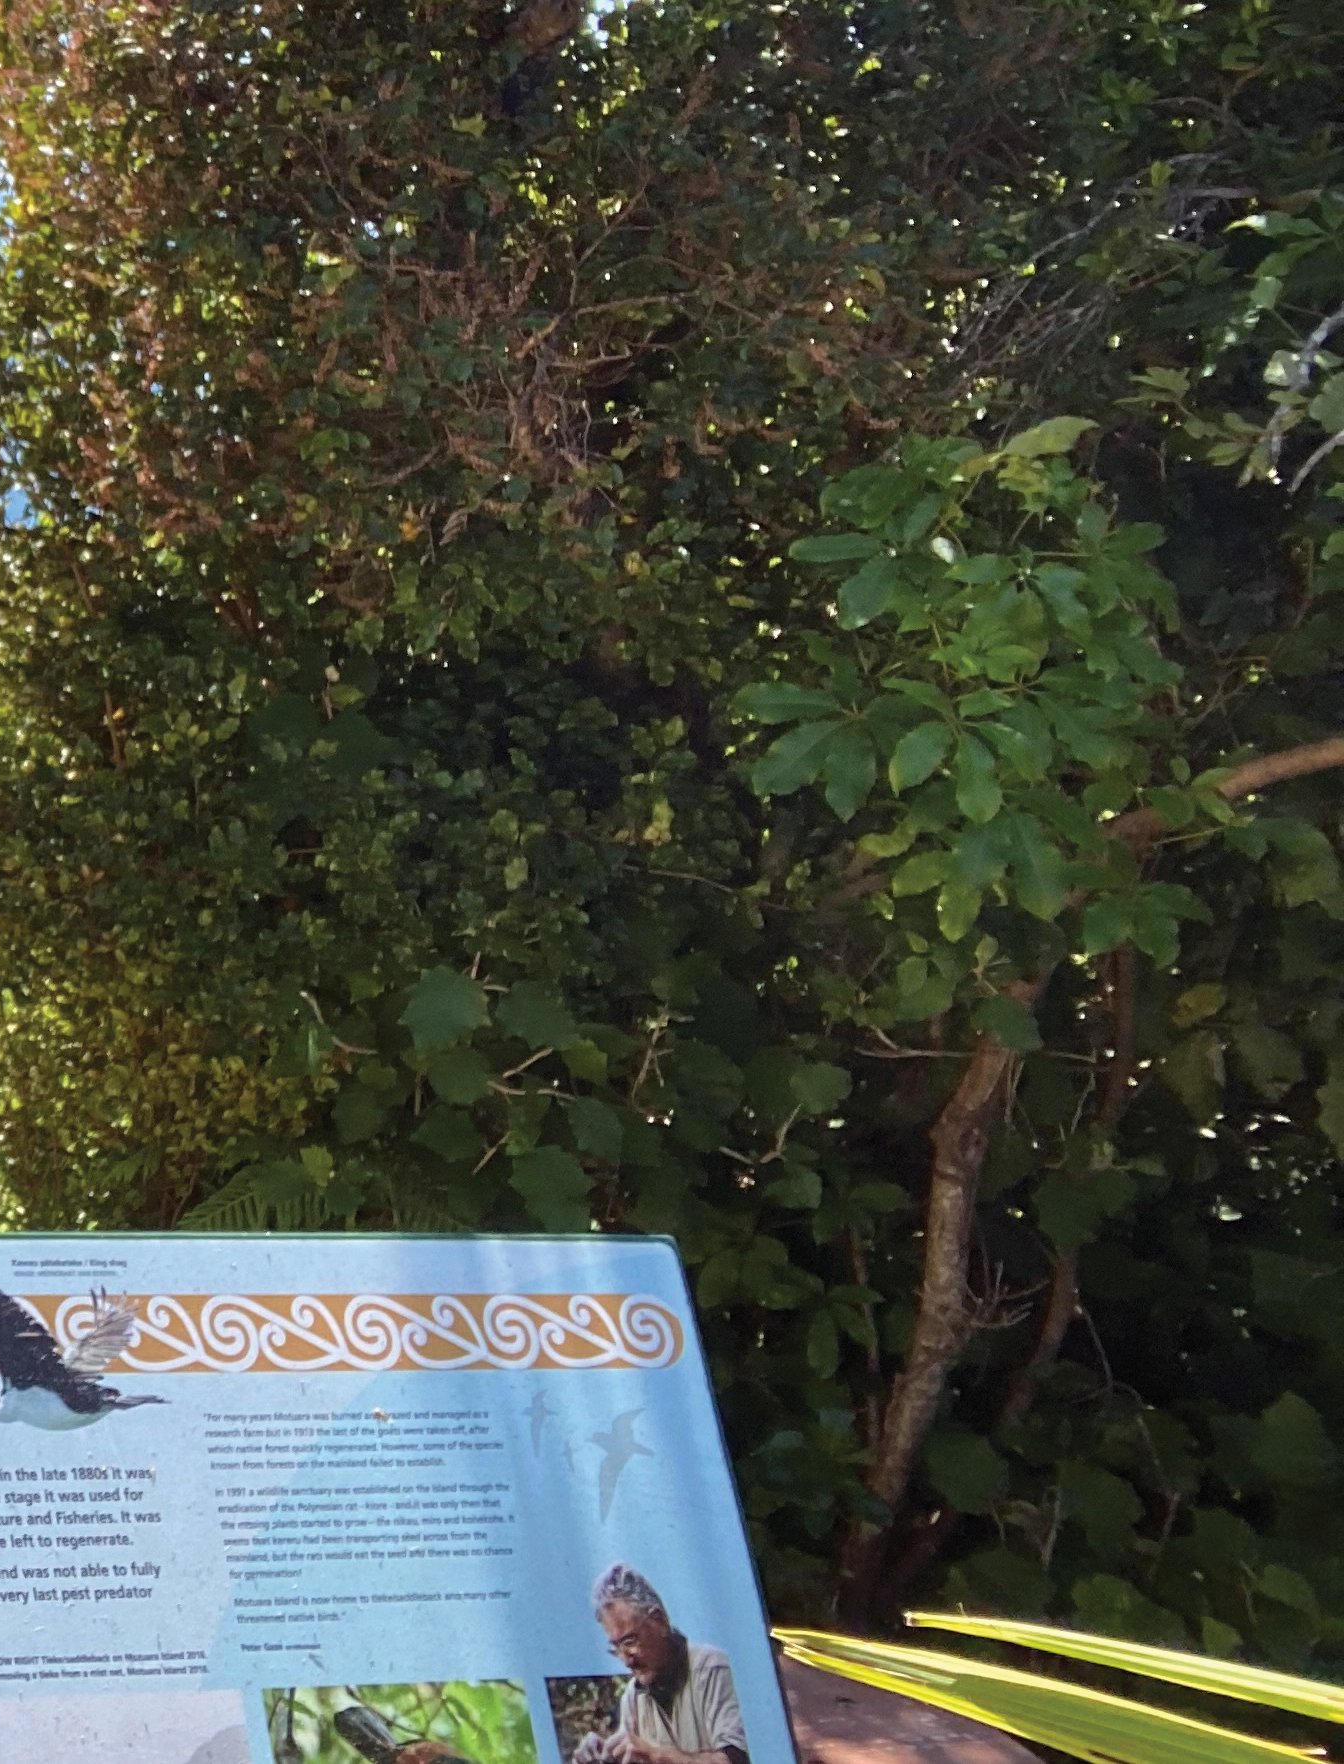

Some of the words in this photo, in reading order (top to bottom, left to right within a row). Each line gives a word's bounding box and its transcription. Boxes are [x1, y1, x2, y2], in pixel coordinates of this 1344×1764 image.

[14, 1467, 38, 1481] the
[40, 1467, 67, 1480] late
[70, 1466, 109, 1480] 1880s
[110, 1466, 122, 1479] it
[124, 1468, 152, 1479] was
[9, 1533, 34, 1547] left
[36, 1533, 52, 1546] to
[55, 1531, 133, 1550] regenerate.
[21, 1567, 49, 1578] was
[52, 1563, 76, 1577] not
[80, 1562, 109, 1576] able
[112, 1562, 127, 1575] to
[130, 1561, 160, 1579] fully
